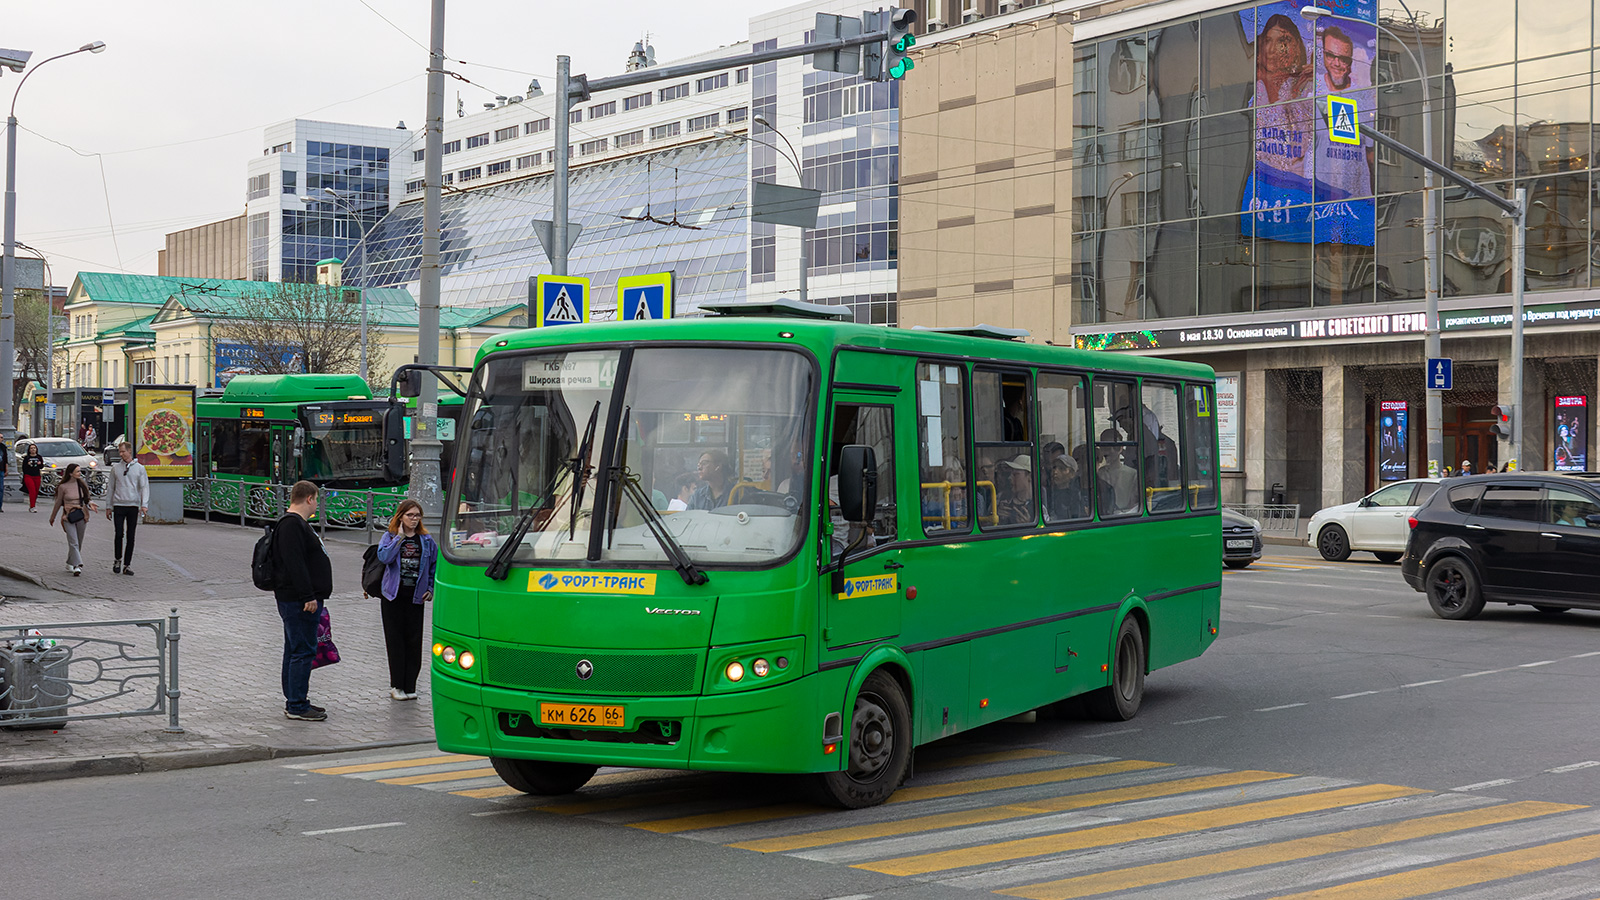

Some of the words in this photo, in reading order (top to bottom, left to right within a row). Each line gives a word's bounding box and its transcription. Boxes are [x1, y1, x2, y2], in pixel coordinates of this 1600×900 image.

[1300, 320, 1326, 337] ПАРК
[1327, 315, 1389, 336] СОВЕТСКОГО
[1445, 316, 1490, 328] романтическая
[1527, 311, 1555, 322] Времени
[1556, 310, 1569, 319] под
[1569, 309, 1593, 320] музыку
[1180, 331, 1185, 342] 8
[1187, 332, 1200, 341] мая
[1202, 329, 1224, 340] 18.30
[1226, 328, 1263, 339] Основная
[1265, 327, 1288, 337] сцена
[544, 362, 560, 371] ГКБ
[563, 362, 576, 370] №7
[529, 376, 565, 386] Широкая
[567, 376, 592, 385] речка
[1381, 402, 1406, 410] СЕГОДНЯ
[1558, 397, 1583, 406] ЗАВТРА
[561, 575, 646, 590] ФОРТ-ТРАНС
[855, 577, 893, 592] ФОРТ-ТРАНС
[547, 709, 564, 722] КМ
[569, 707, 597, 723] 626
[604, 708, 619, 720] 66
